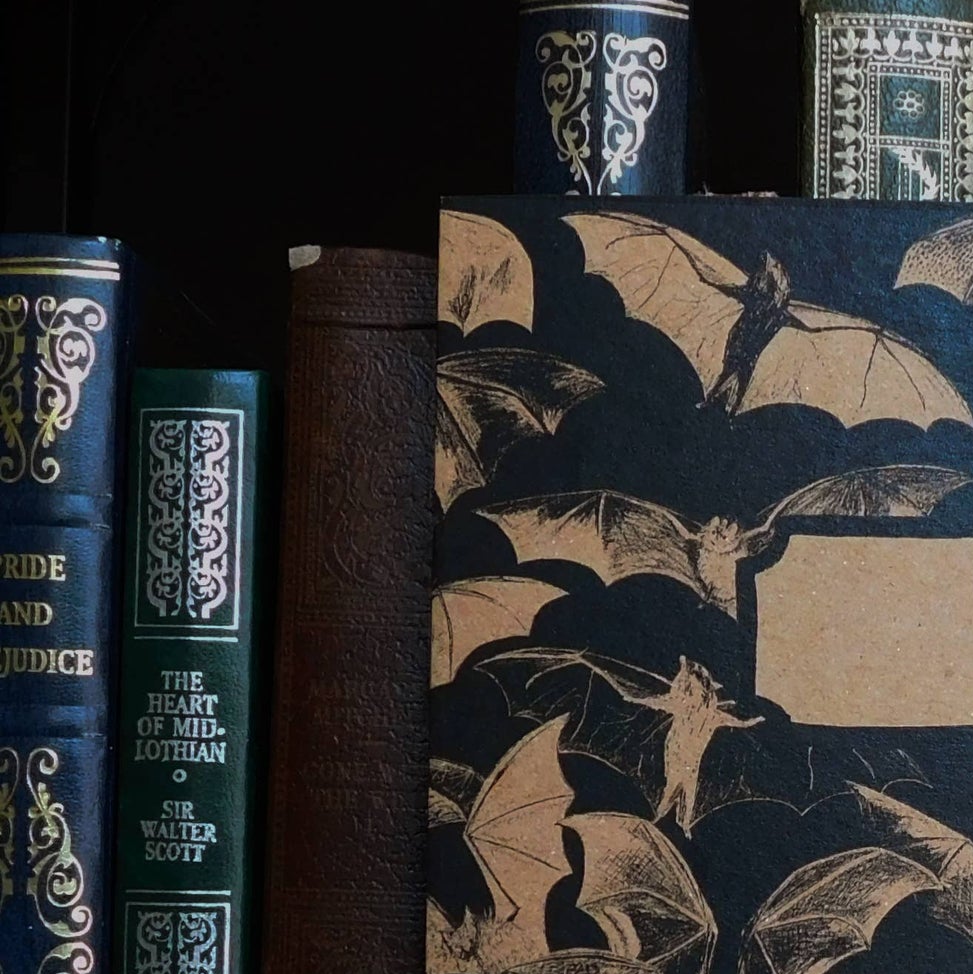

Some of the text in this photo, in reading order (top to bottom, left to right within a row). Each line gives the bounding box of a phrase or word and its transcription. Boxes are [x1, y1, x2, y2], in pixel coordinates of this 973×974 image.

[0, 553, 66, 582] RIDE
[0, 601, 53, 627] AND
[160, 670, 204, 692] THE
[146, 692, 219, 716] HEART
[137, 716, 164, 737] OF
[134, 739, 227, 764] LOTHIAN
[160, 800, 195, 820] SIR
[140, 820, 217, 843] WALTER
[144, 841, 206, 863] SCOTT
